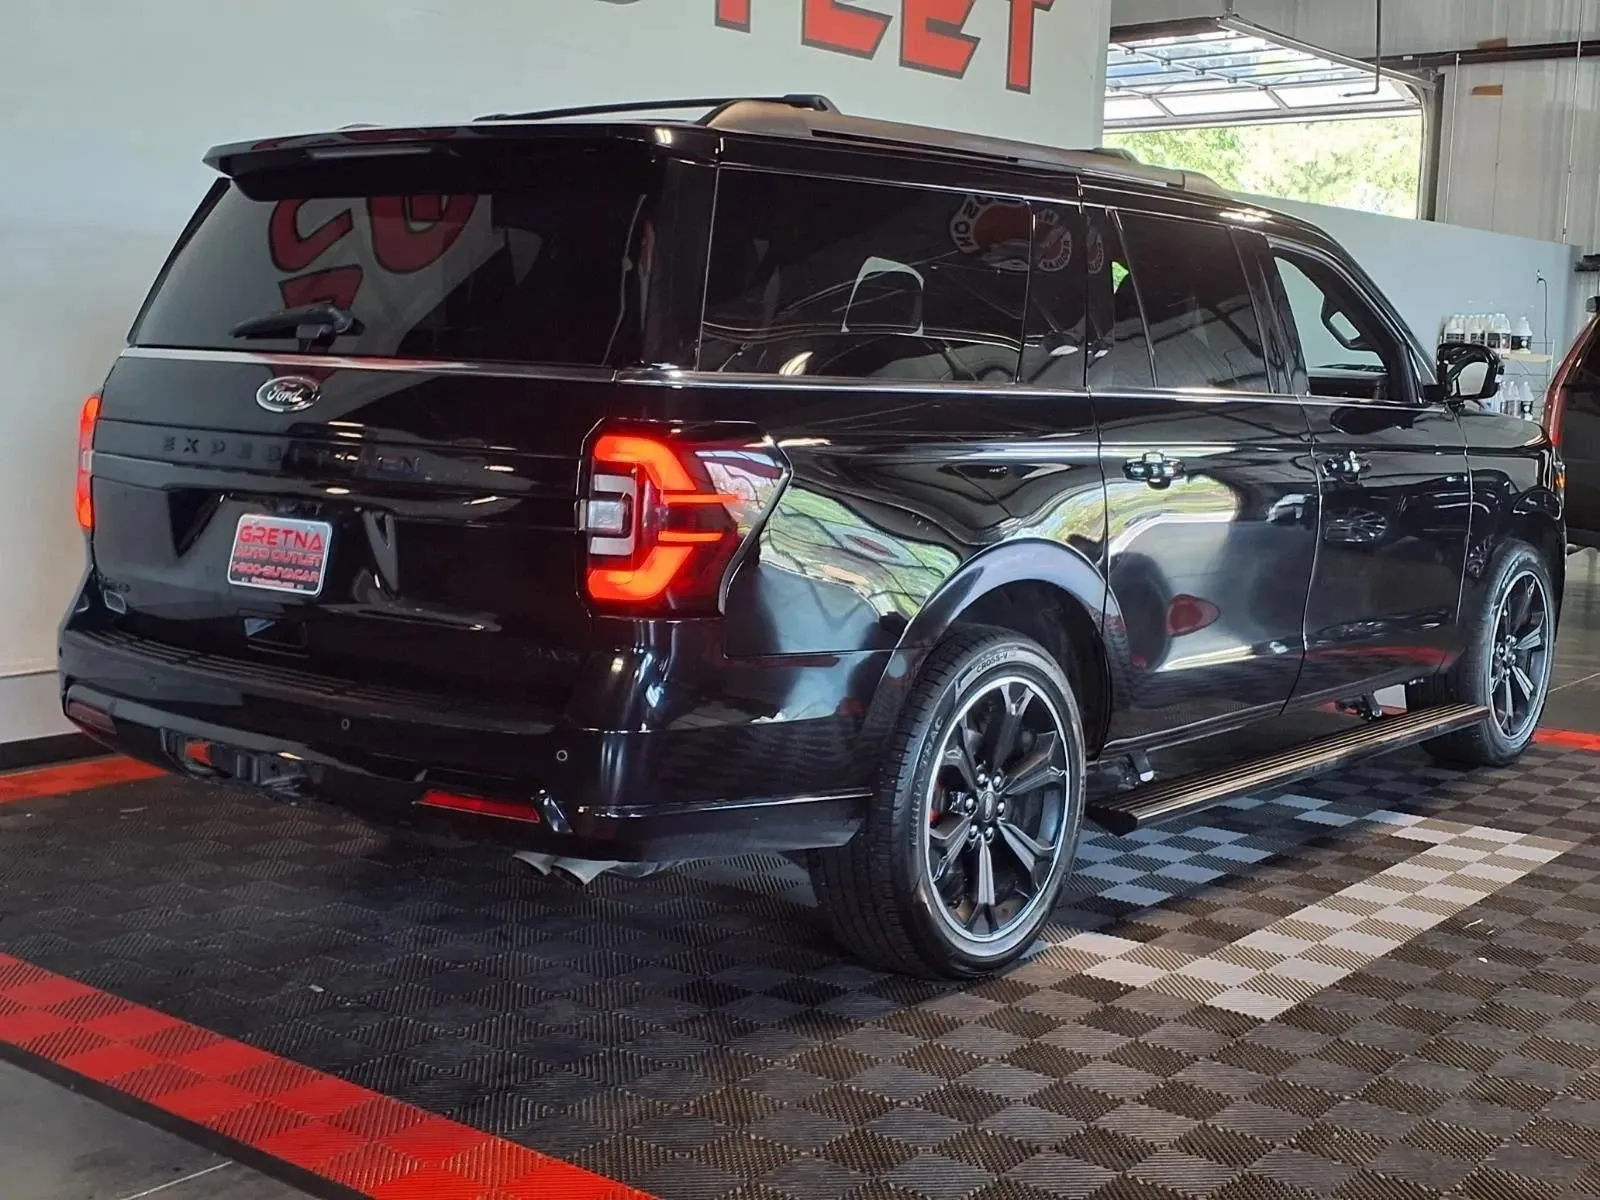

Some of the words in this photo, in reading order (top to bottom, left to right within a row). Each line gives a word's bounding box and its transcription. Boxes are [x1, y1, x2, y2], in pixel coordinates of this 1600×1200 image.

[266, 382, 305, 403] Ford
[240, 525, 322, 550] GRETNA
[235, 546, 269, 560] AUTO
[271, 550, 322, 566] OUTLET
[976, 652, 1009, 674] CROSS-V
